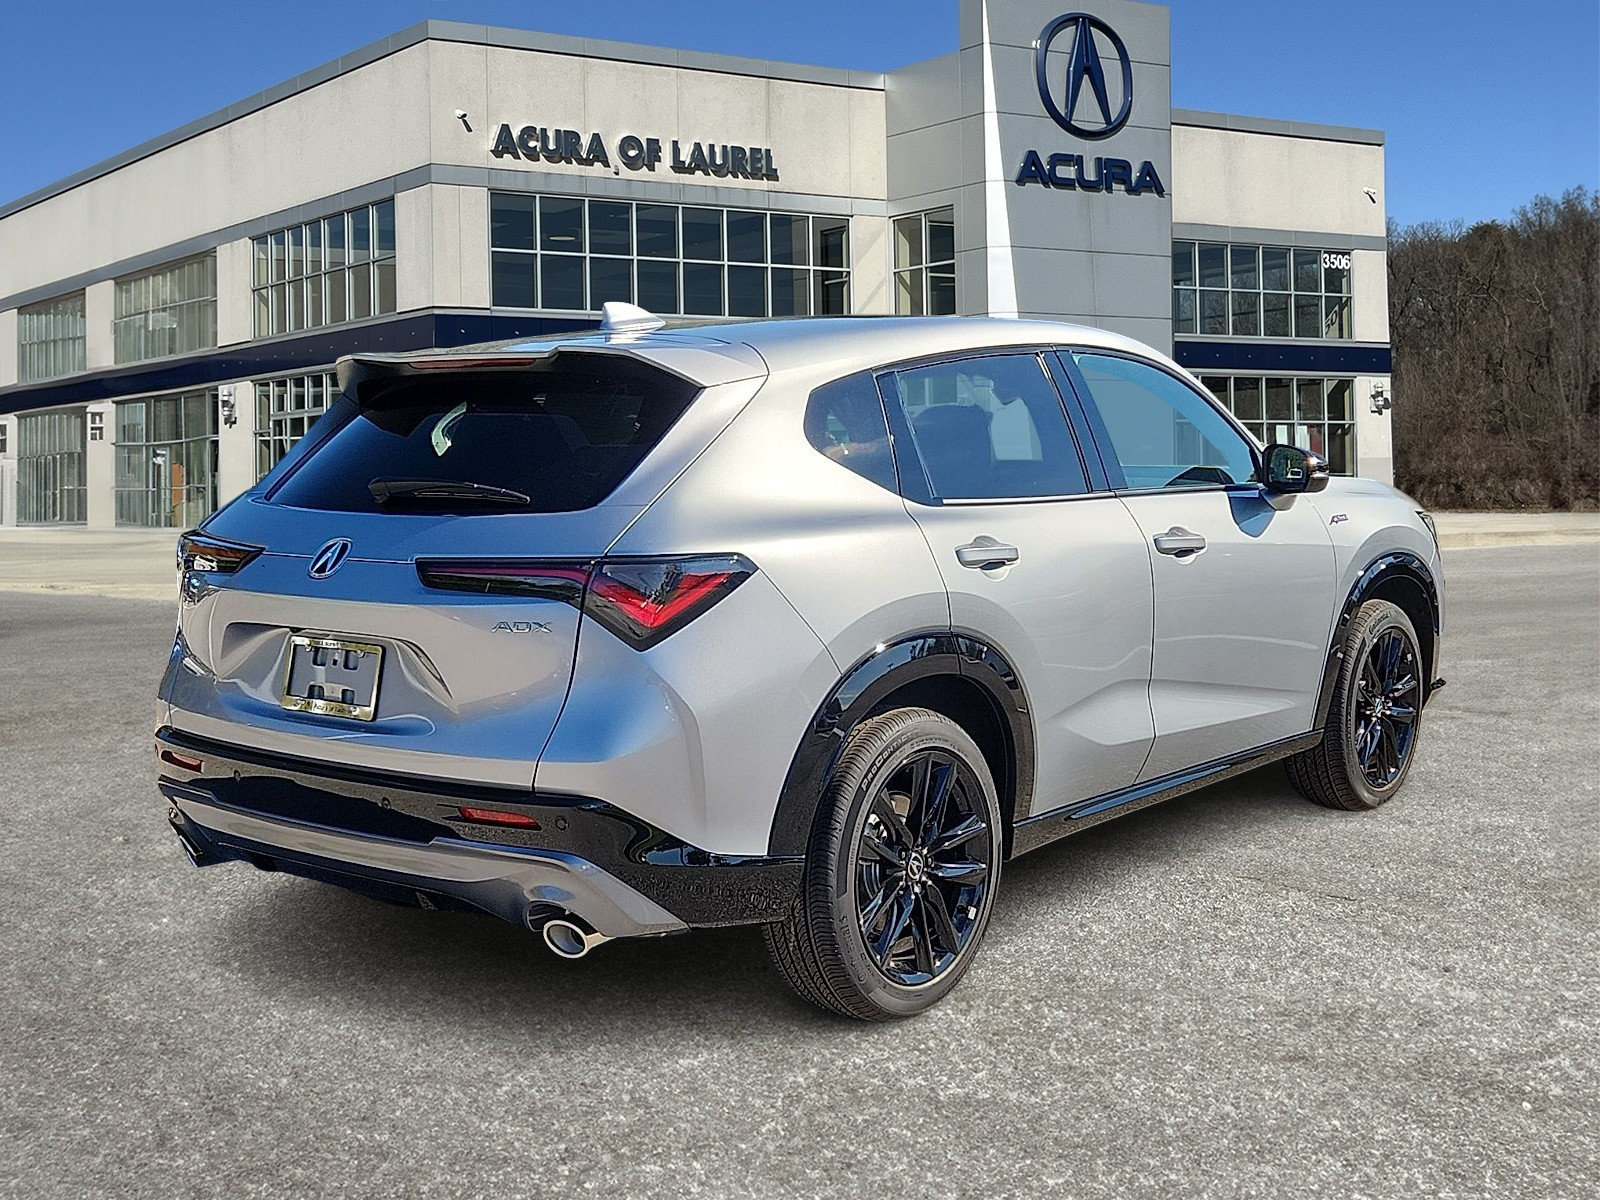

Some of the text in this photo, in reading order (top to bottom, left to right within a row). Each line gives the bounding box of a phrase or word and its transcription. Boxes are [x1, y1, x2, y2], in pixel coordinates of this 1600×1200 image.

[492, 123, 778, 180] ACURA OF LAUREL
[1016, 149, 1165, 196] ACURA
[1322, 253, 1351, 270] 3506
[491, 621, 553, 634] ADX
